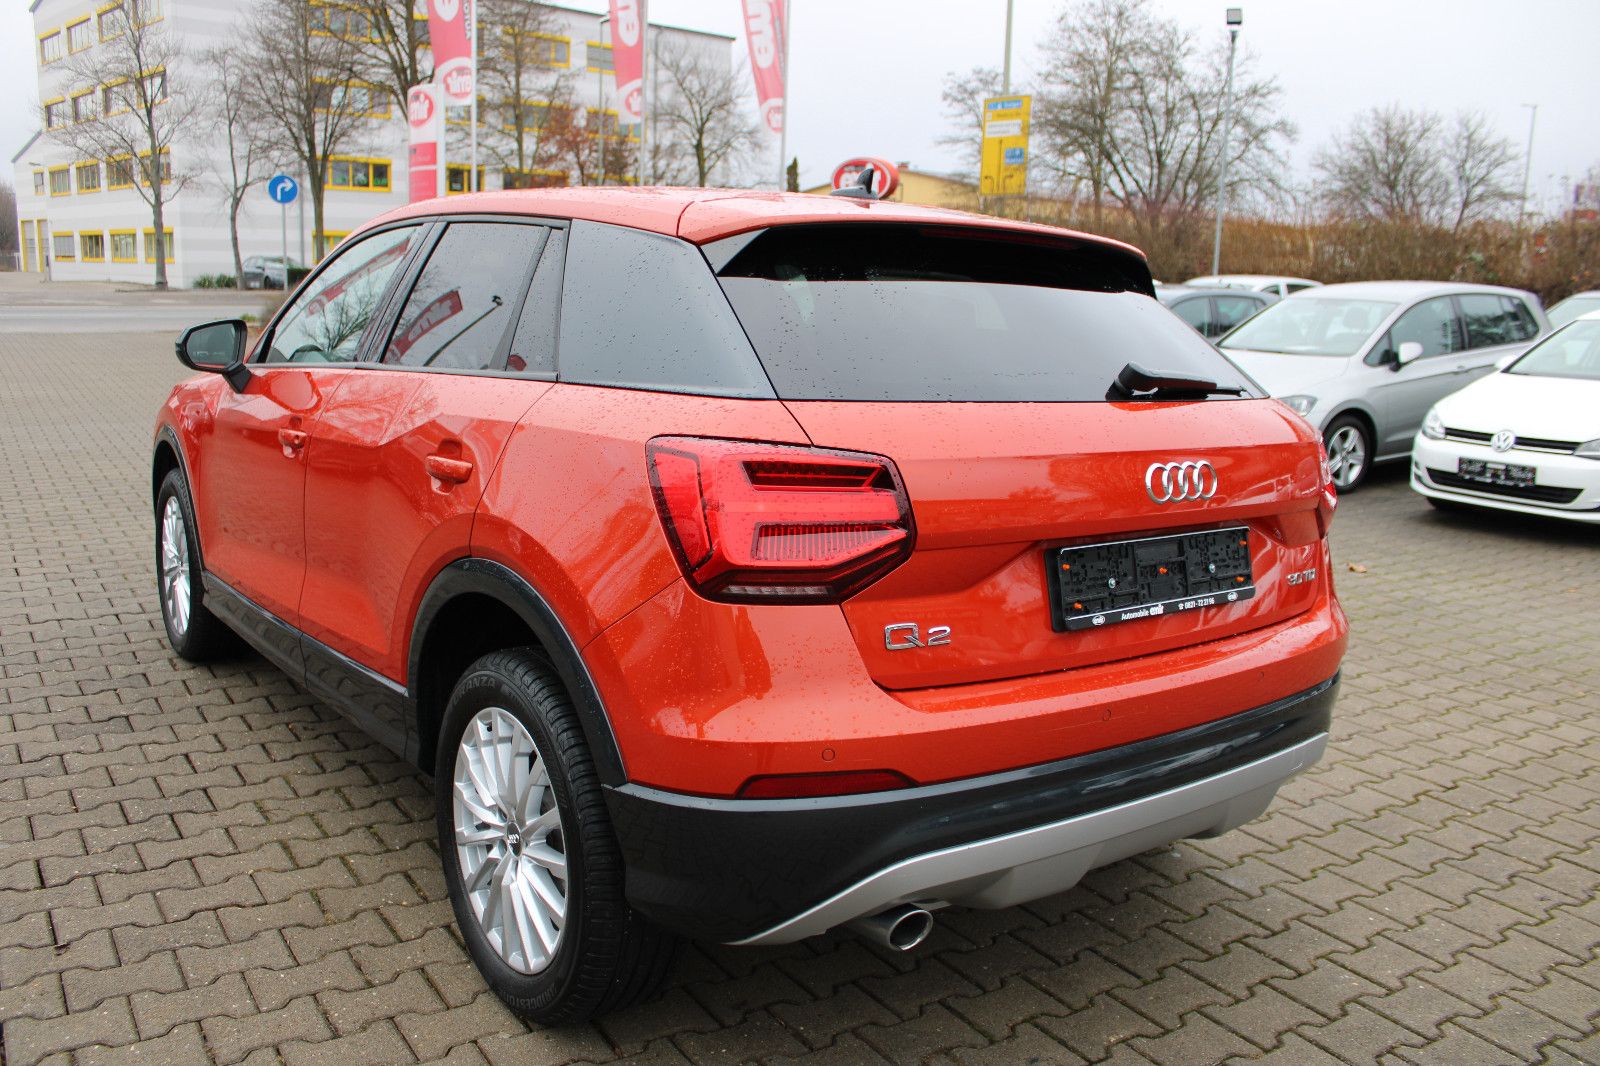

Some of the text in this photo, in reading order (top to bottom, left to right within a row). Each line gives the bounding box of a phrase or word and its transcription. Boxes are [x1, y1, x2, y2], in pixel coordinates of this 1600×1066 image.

[1121, 603, 1164, 620] Automobile emir
[885, 622, 951, 650] Q2
